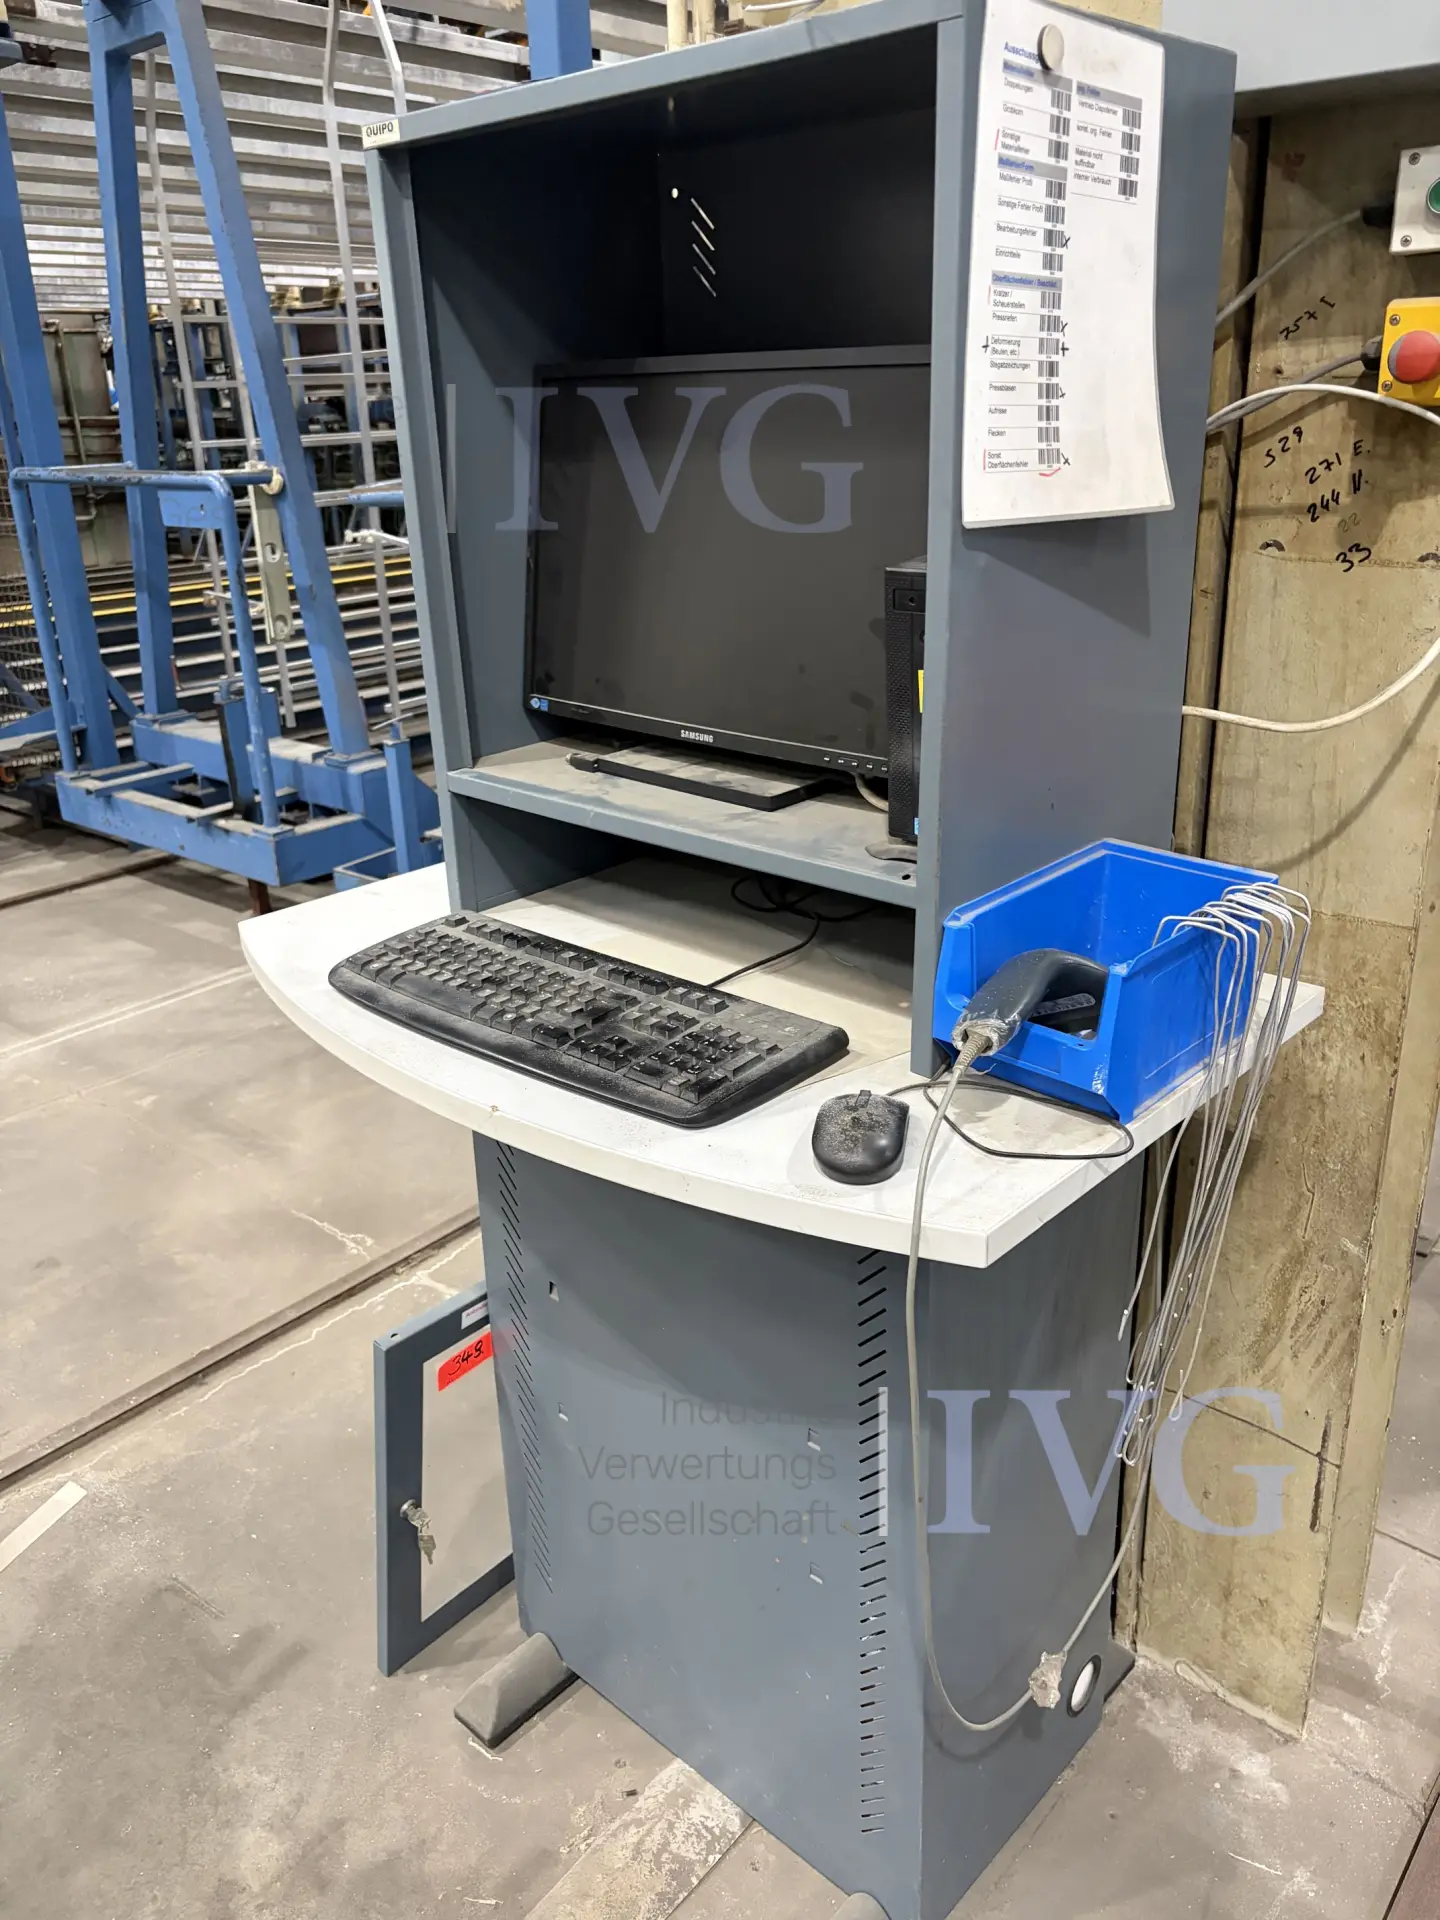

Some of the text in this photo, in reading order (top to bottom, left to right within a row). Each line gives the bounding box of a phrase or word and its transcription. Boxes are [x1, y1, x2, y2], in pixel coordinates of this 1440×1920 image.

[366, 121, 394, 138] QUIPO
[997, 197, 1017, 210] Sonstige
[1306, 488, 1340, 523] 244
[1335, 543, 1372, 572] 33
[680, 729, 714, 743] SAMSUNG
